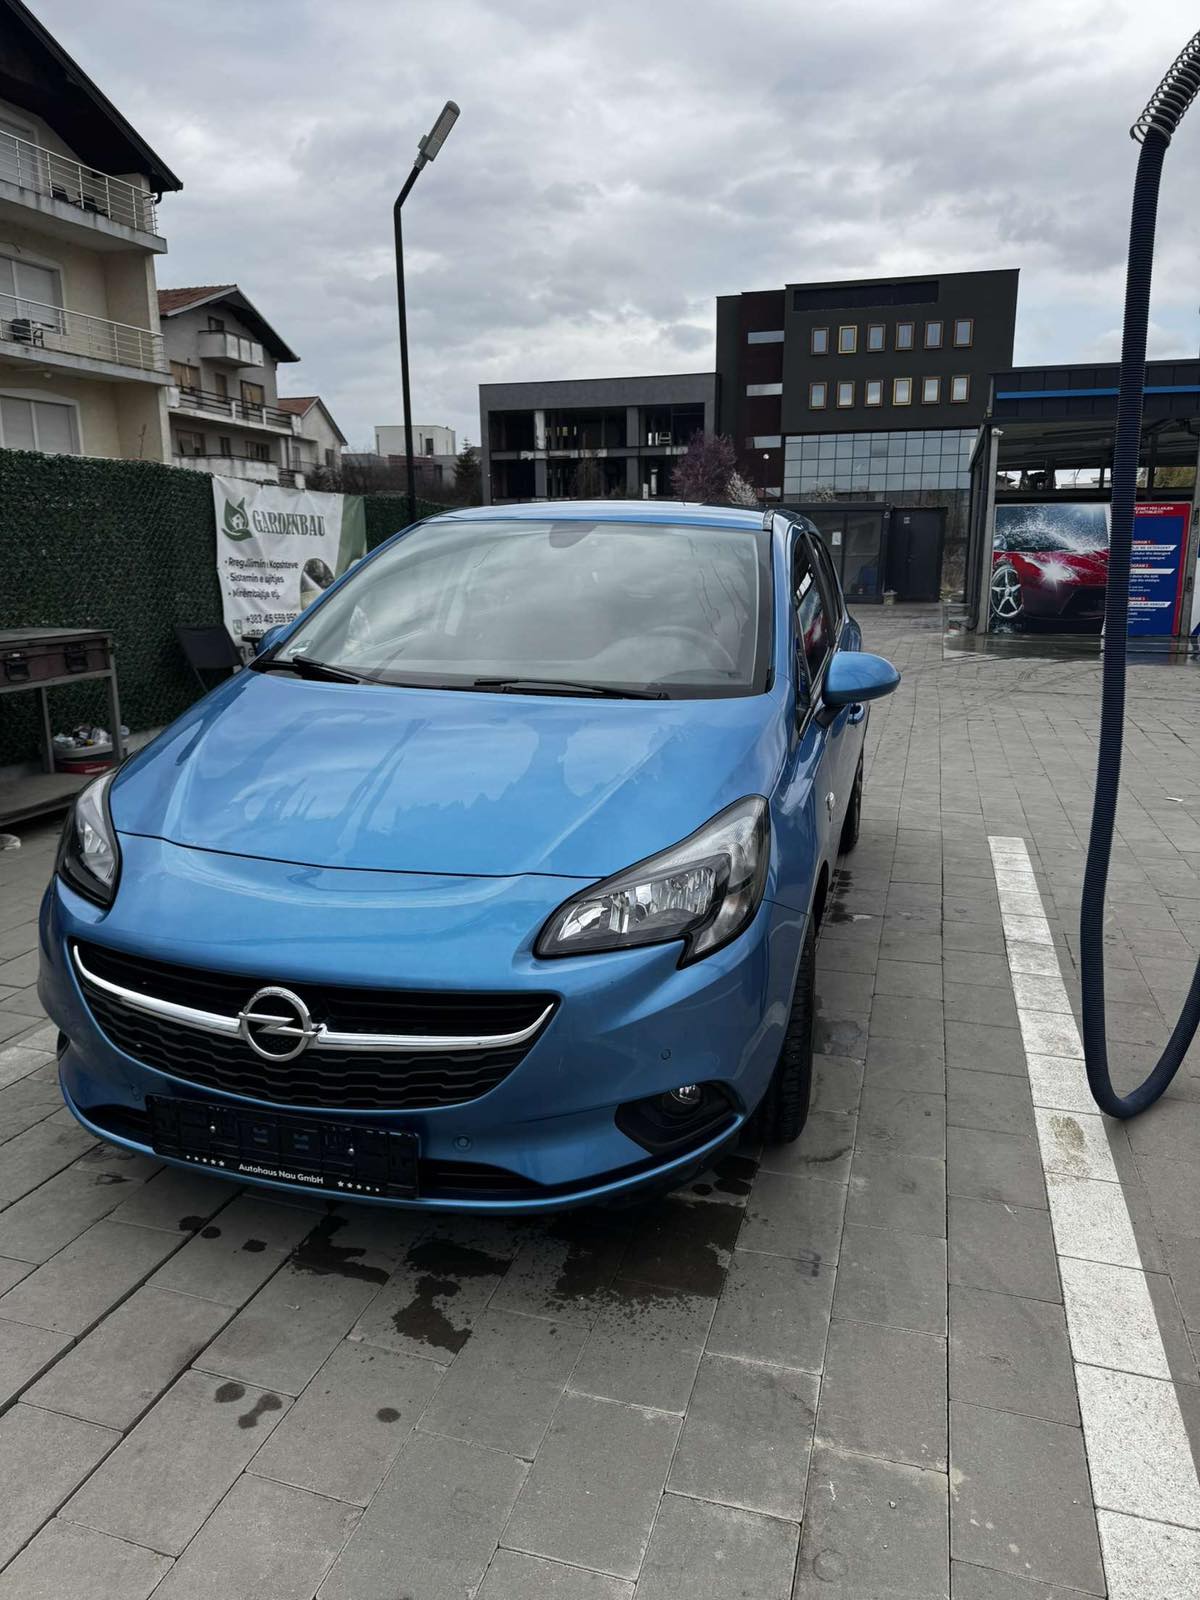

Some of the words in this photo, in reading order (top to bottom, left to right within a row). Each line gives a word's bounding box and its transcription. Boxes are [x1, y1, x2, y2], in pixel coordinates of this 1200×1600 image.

[253, 510, 325, 536] GARDENBAU
[238, 1163, 277, 1176] Autohaus
[278, 1170, 296, 1179] Nau
[297, 1173, 324, 1184] GmbH
